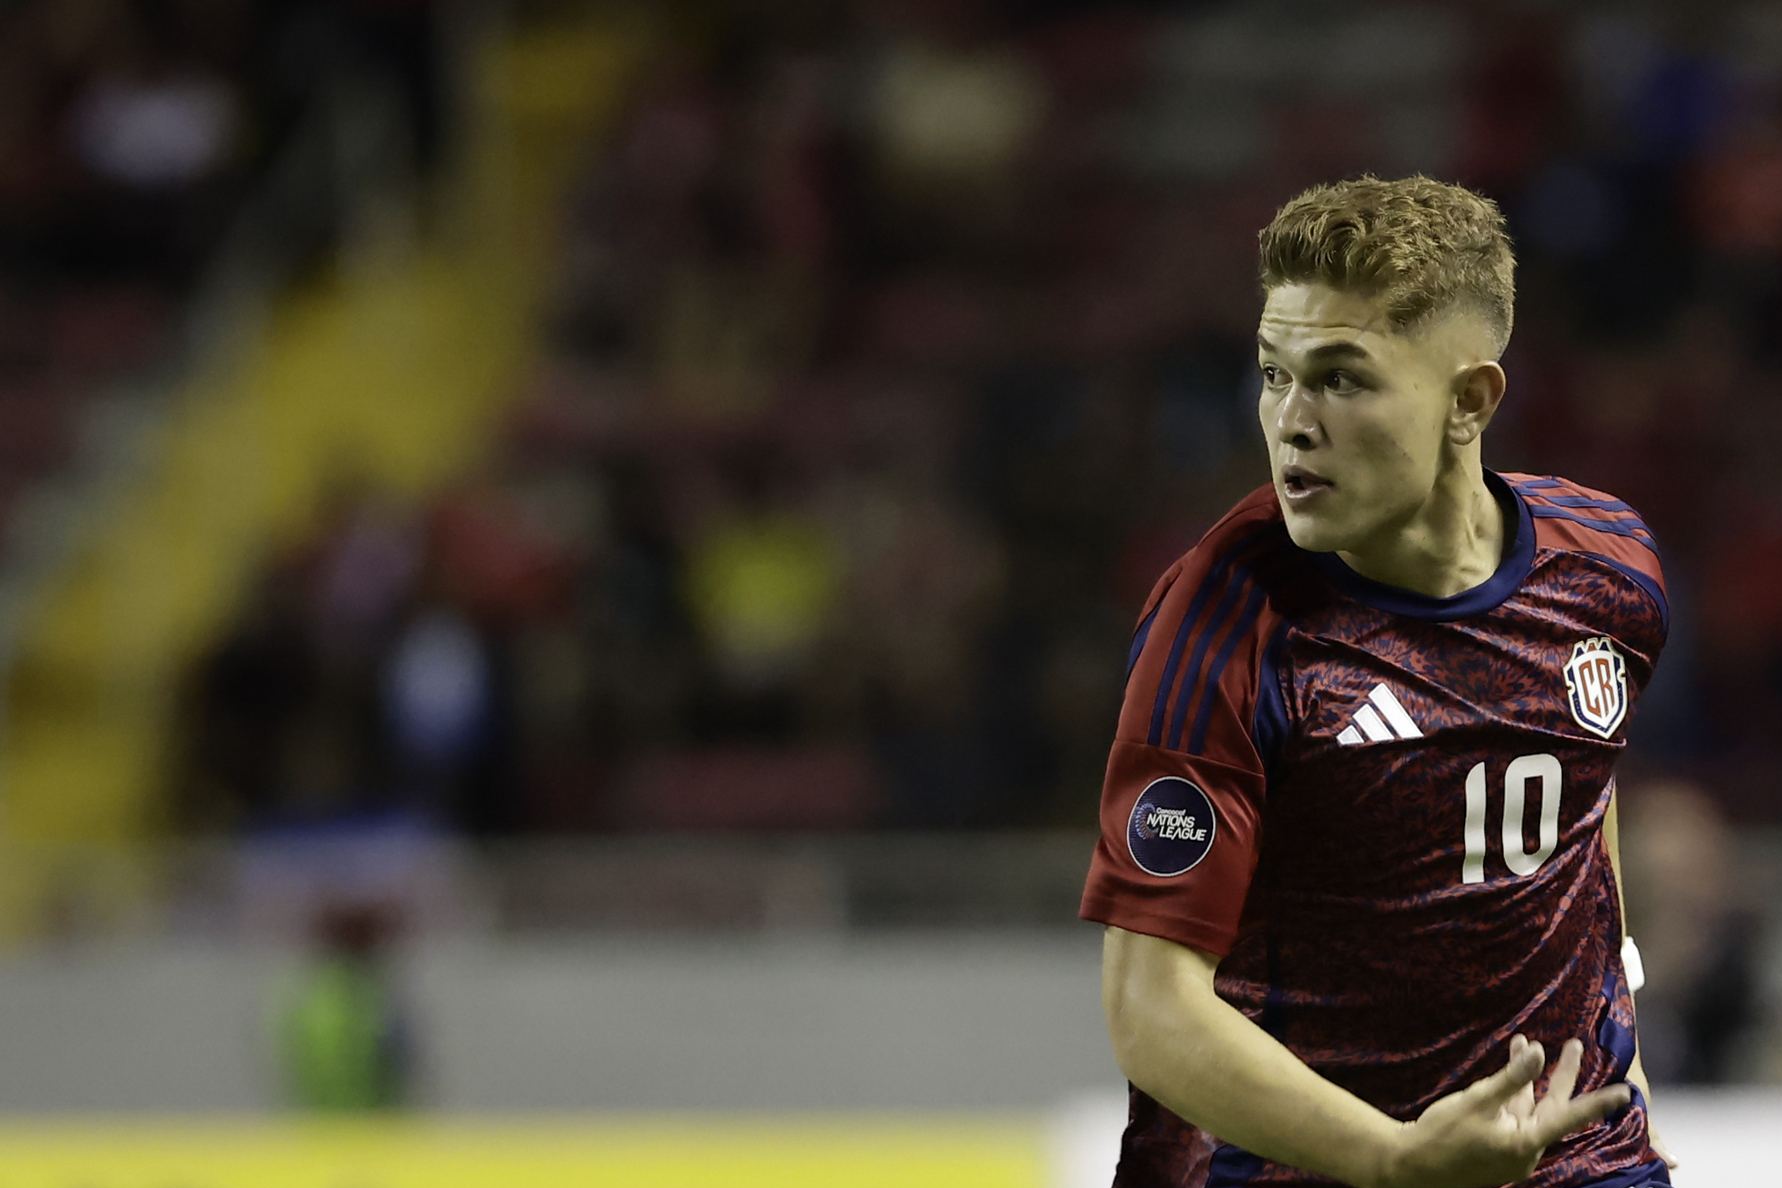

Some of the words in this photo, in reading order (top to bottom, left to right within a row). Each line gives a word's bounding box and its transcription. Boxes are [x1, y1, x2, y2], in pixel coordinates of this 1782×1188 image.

[1147, 813, 1195, 828] NATIONS
[1461, 752, 1564, 885] 10
[1159, 826, 1207, 841] LEAGUE
